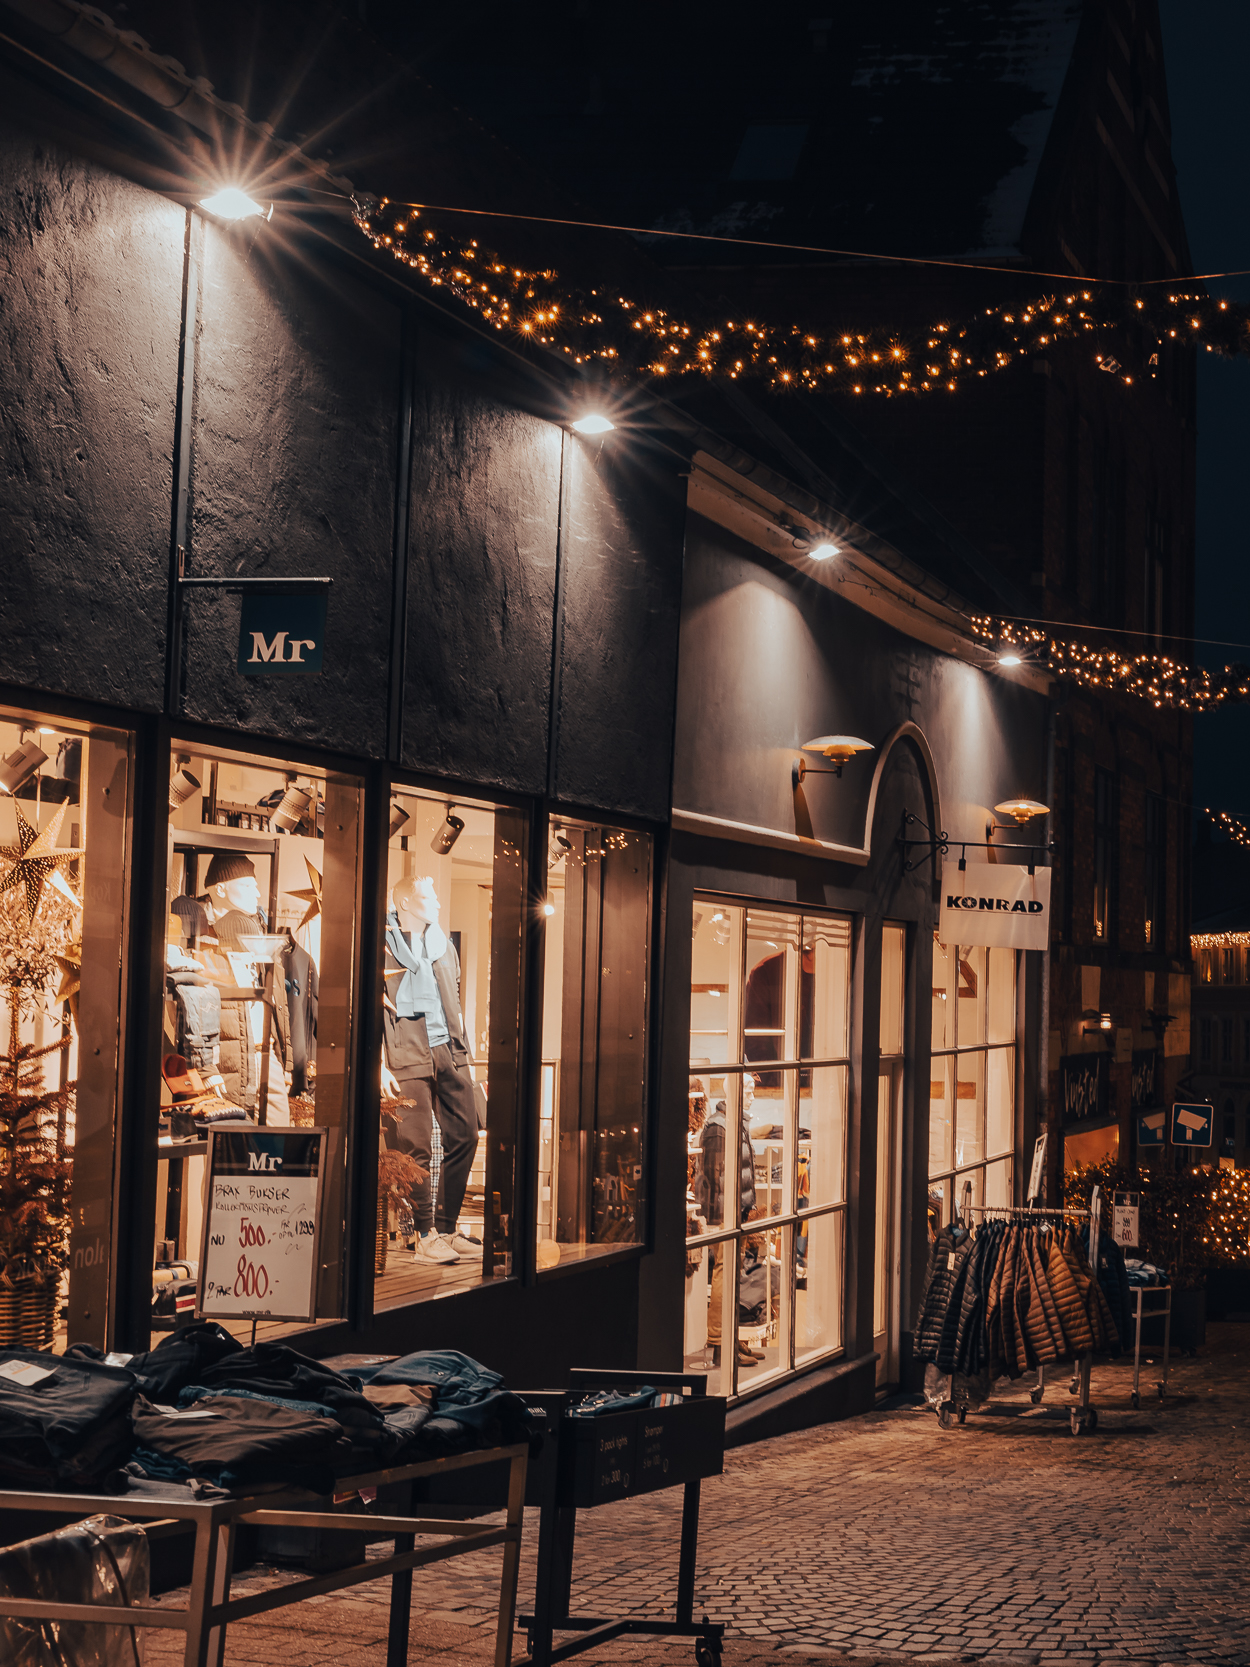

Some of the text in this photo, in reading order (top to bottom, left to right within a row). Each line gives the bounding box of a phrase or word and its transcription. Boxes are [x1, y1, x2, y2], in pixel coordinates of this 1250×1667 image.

[247, 632, 316, 662] Mr
[946, 895, 1043, 913] KONRAD
[247, 1152, 283, 1171] Mr
[211, 1234, 225, 1245] NU
